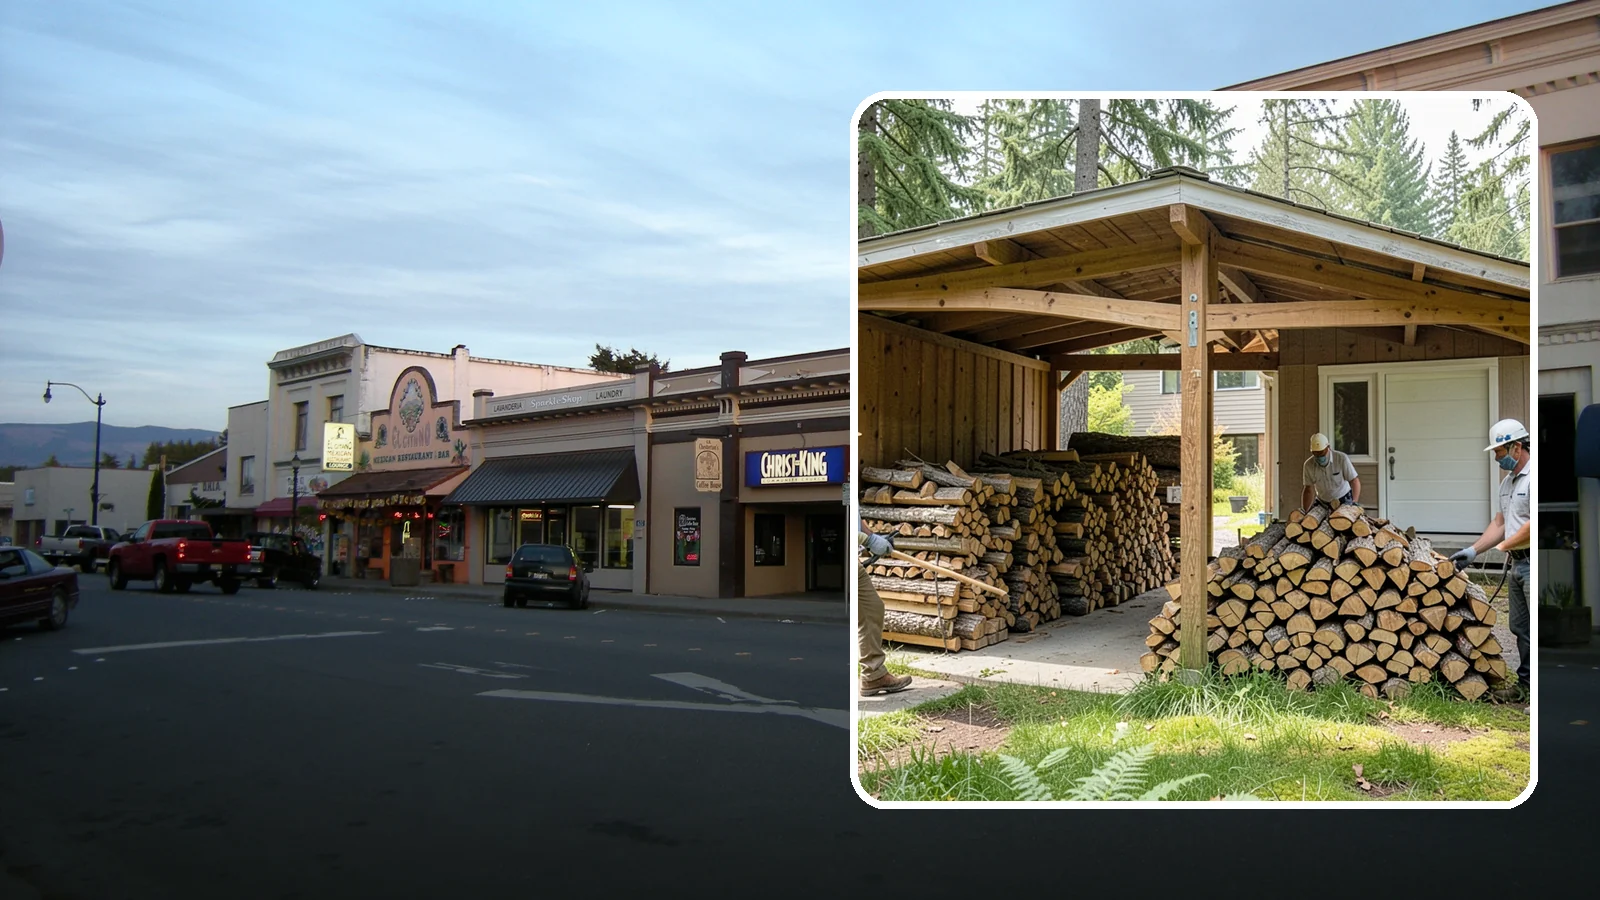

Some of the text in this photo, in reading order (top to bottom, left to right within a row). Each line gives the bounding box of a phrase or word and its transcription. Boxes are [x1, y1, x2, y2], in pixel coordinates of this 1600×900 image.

[493, 402, 522, 412] LAVANDERIA
[595, 389, 623, 400] LAUNDRY
[373, 450, 450, 464] MEXICAN RESTAURANT BAR
[799, 450, 827, 476] KING
